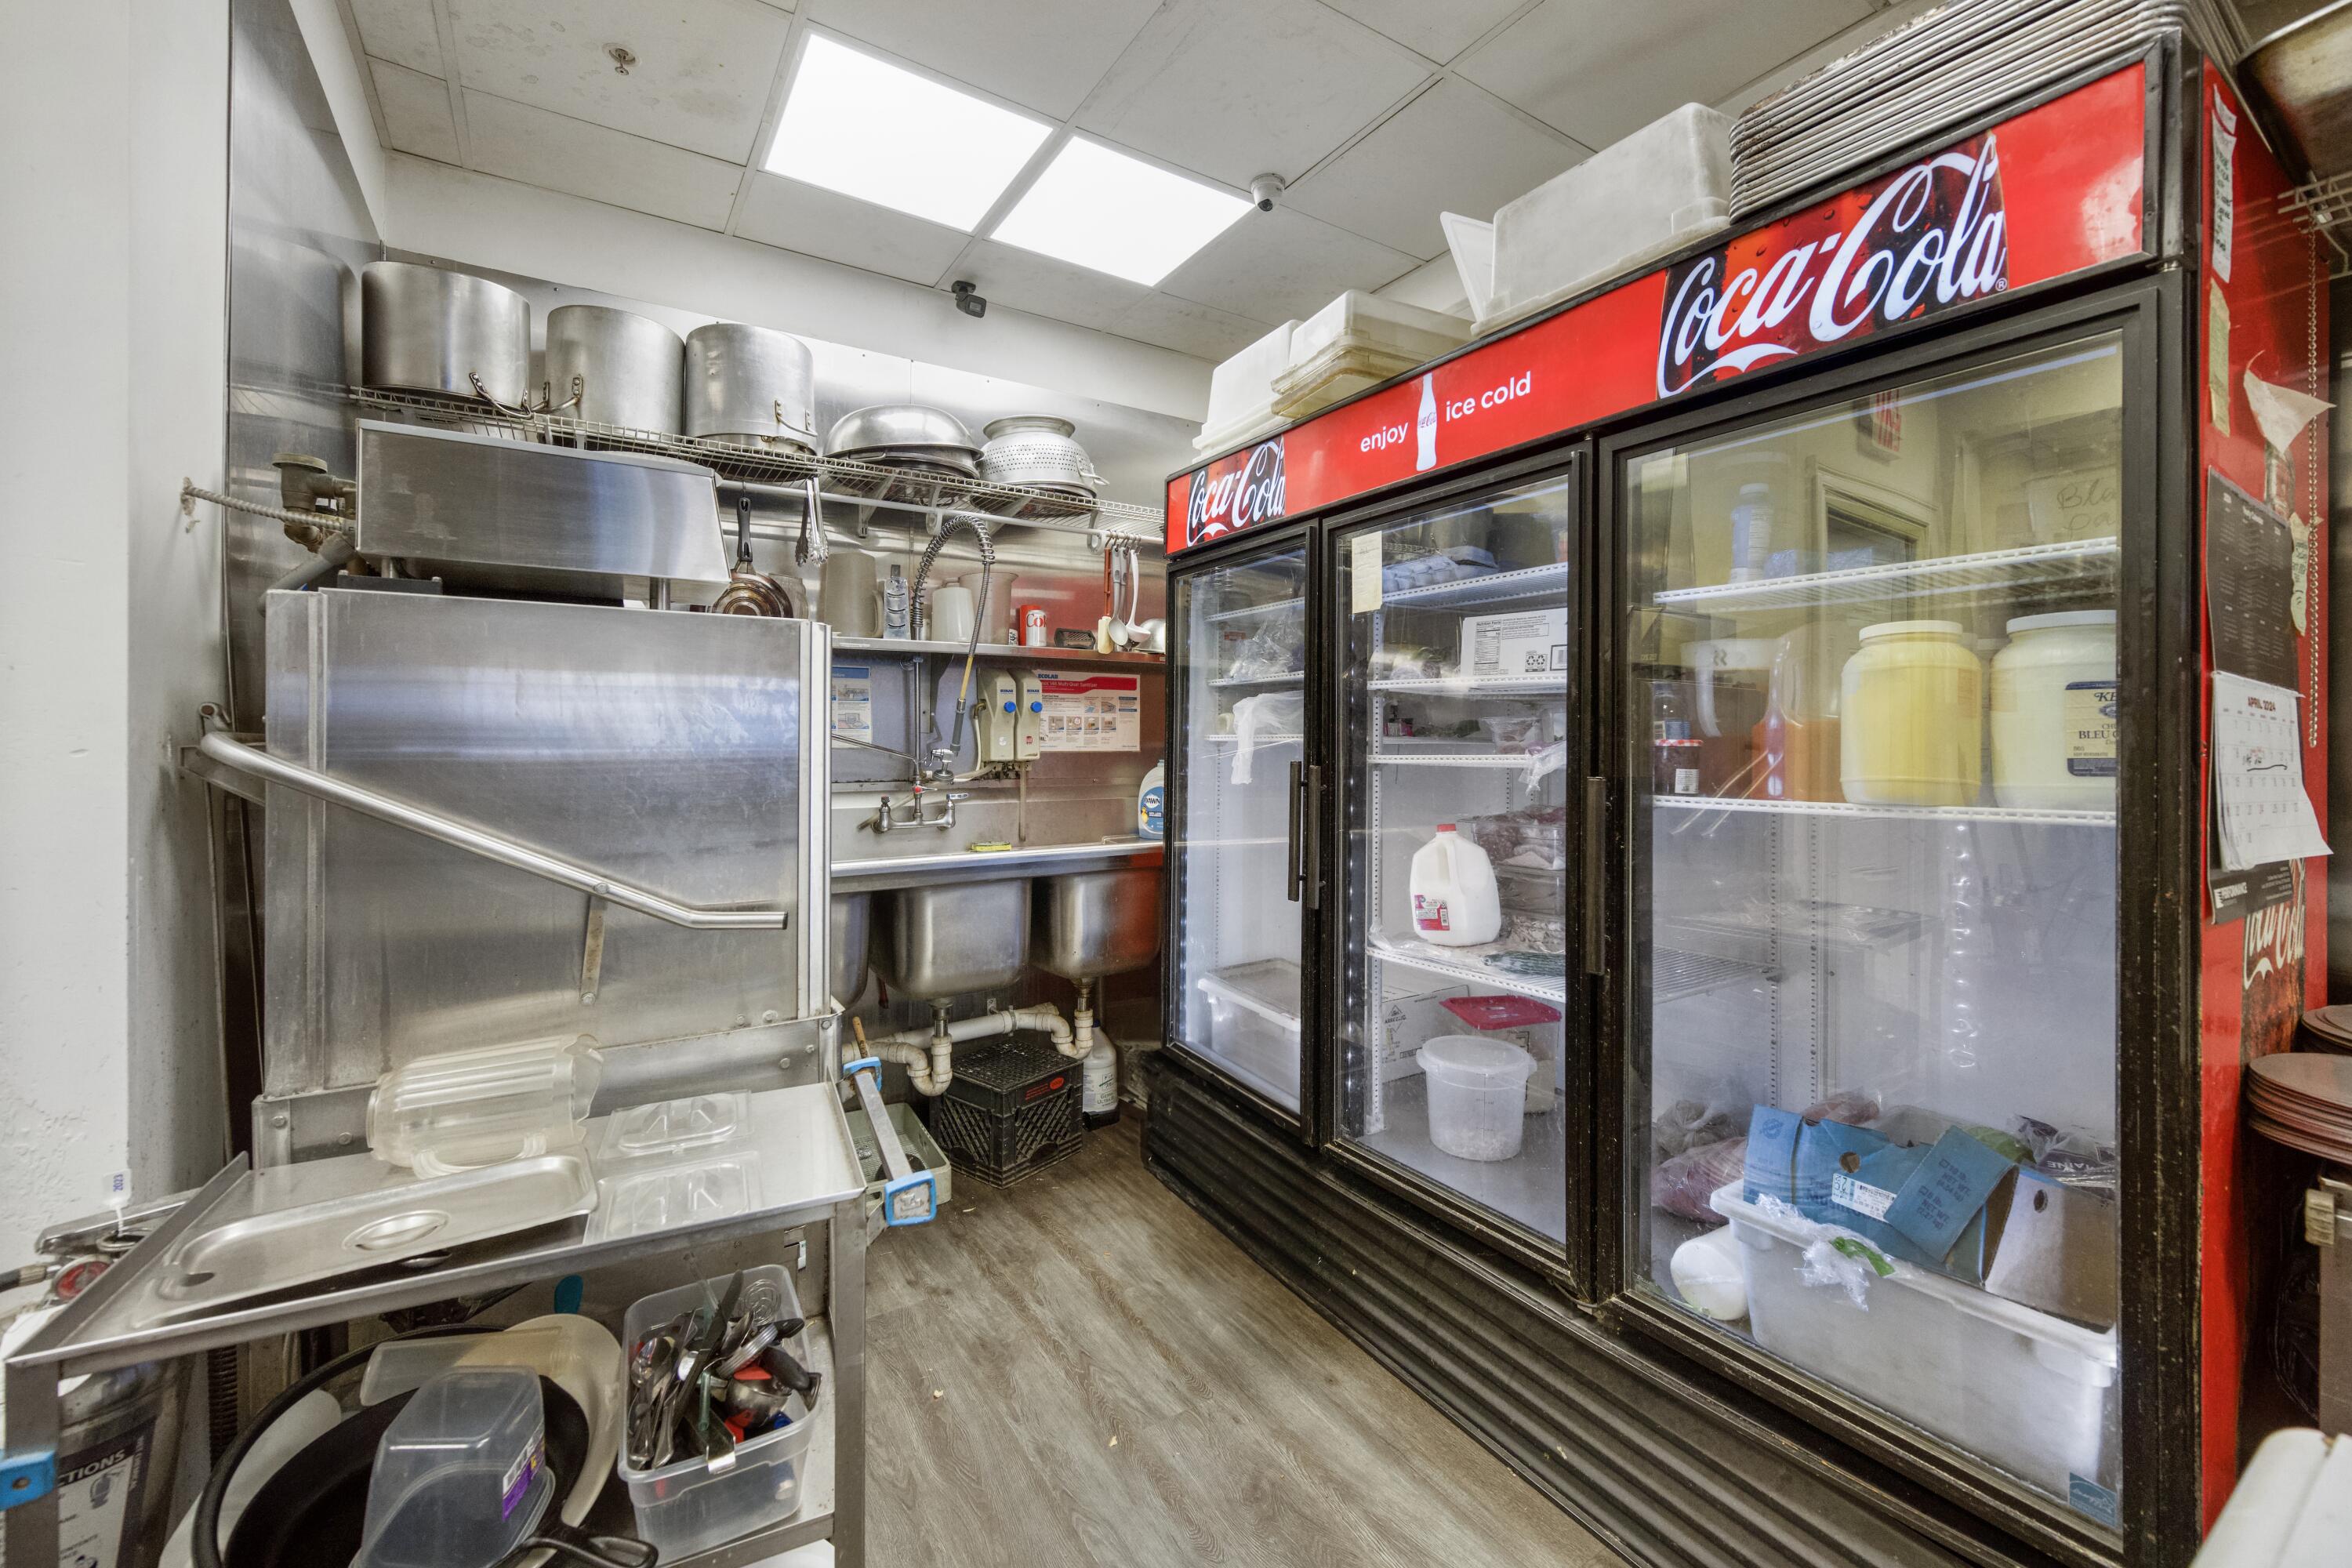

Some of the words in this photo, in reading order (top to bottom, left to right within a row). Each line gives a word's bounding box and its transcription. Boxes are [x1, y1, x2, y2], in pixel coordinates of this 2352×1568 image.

[1657, 135, 2007, 399] Coca-Cola
[1446, 397, 1476, 422] ice
[1481, 371, 1531, 408] cold
[1360, 422, 1409, 452] enjoy
[1186, 434, 1286, 547] Coca-Cola
[2248, 695, 2263, 709] APRIL
[2078, 730, 2110, 739] BLEU
[1144, 796, 1161, 804] DAWN
